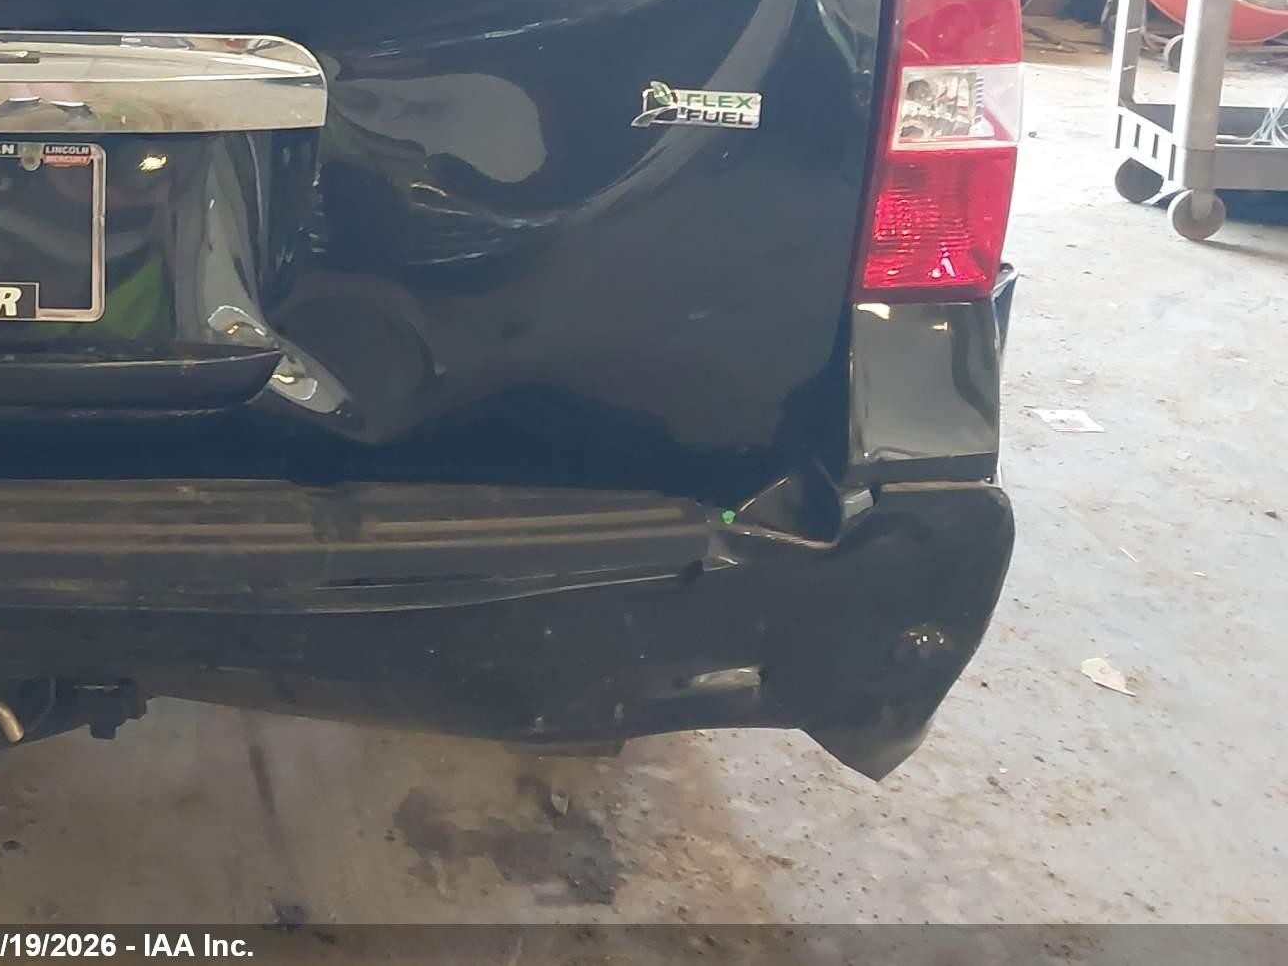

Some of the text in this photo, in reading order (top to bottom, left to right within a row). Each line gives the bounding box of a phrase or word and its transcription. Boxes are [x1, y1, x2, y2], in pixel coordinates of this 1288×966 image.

[686, 93, 753, 109] FLEX
[686, 110, 753, 126] FUEL
[45, 145, 90, 155] LINCOLN
